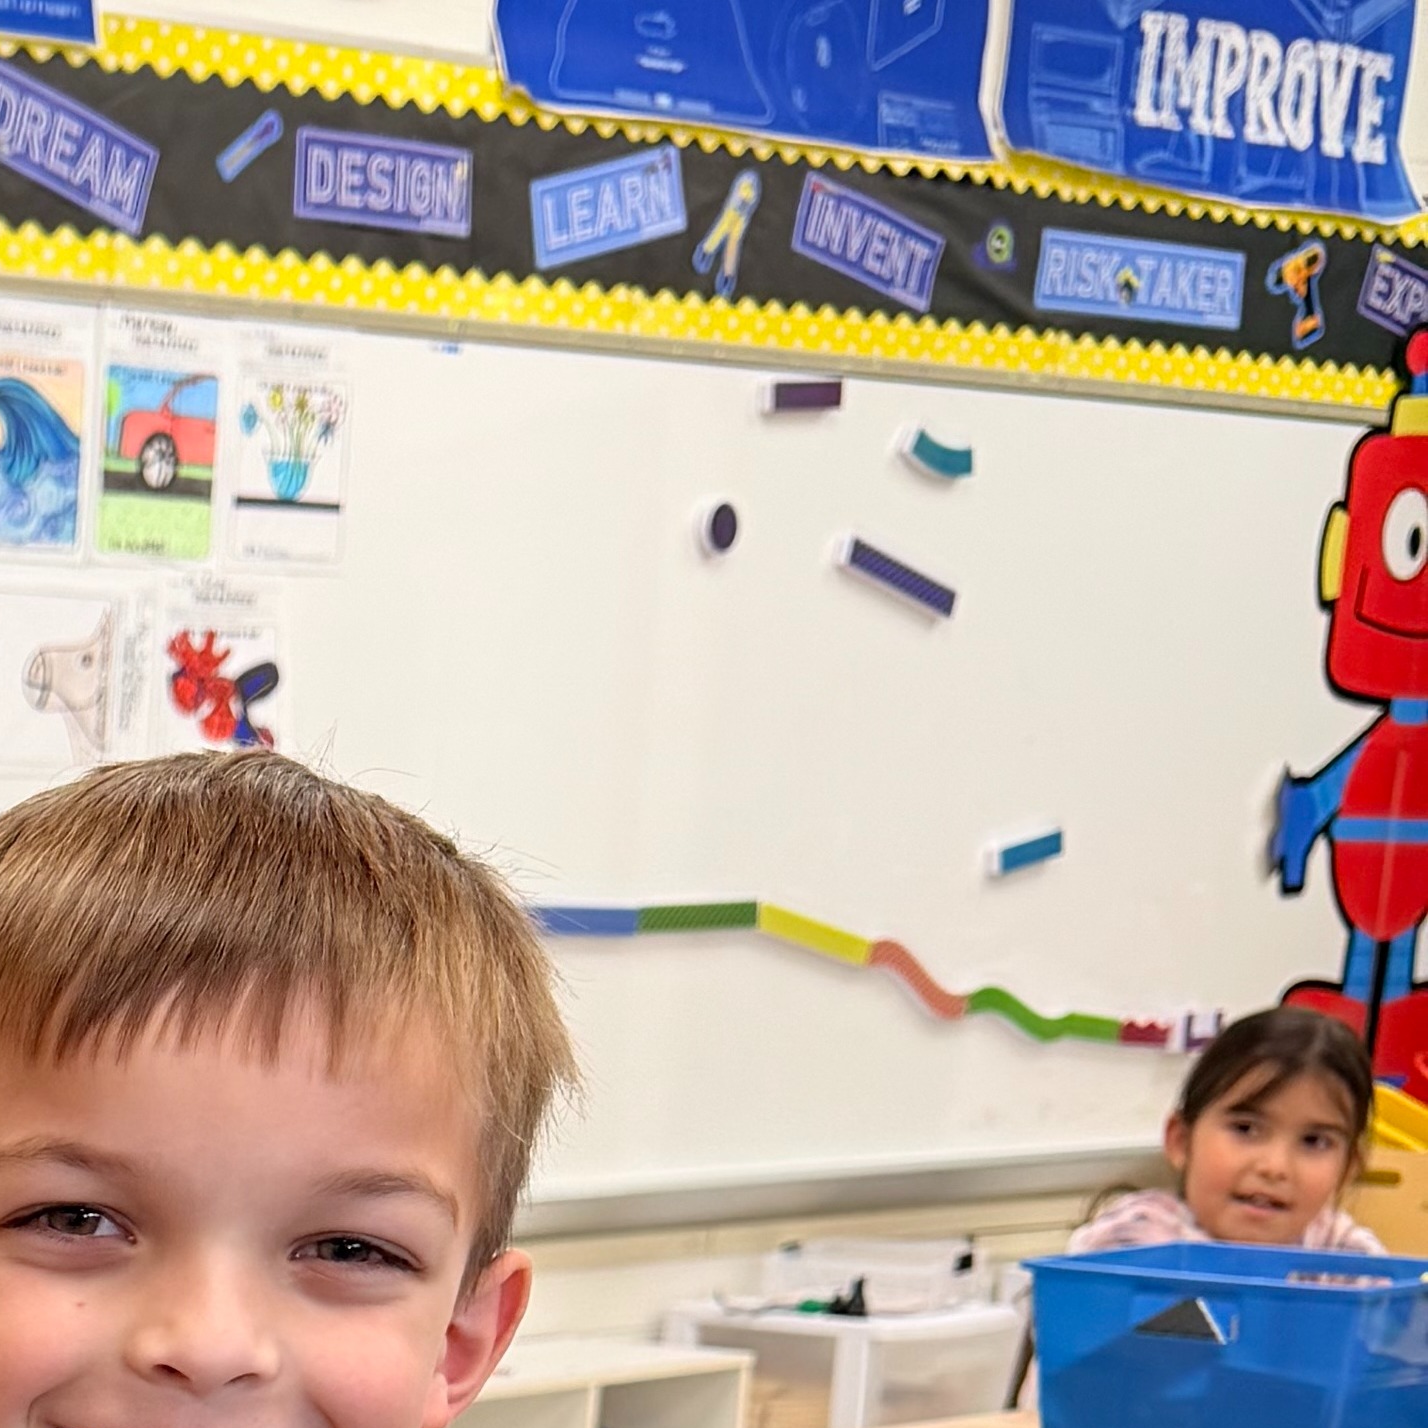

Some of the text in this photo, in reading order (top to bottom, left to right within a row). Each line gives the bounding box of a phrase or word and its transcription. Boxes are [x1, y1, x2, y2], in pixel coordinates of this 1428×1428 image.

[1135, 10, 1394, 165] IMPROVE
[306, 143, 466, 219] DESIGN
[544, 160, 675, 250] LEARN
[805, 193, 932, 295] INVENT
[1045, 246, 1235, 315] RISK TAKER
